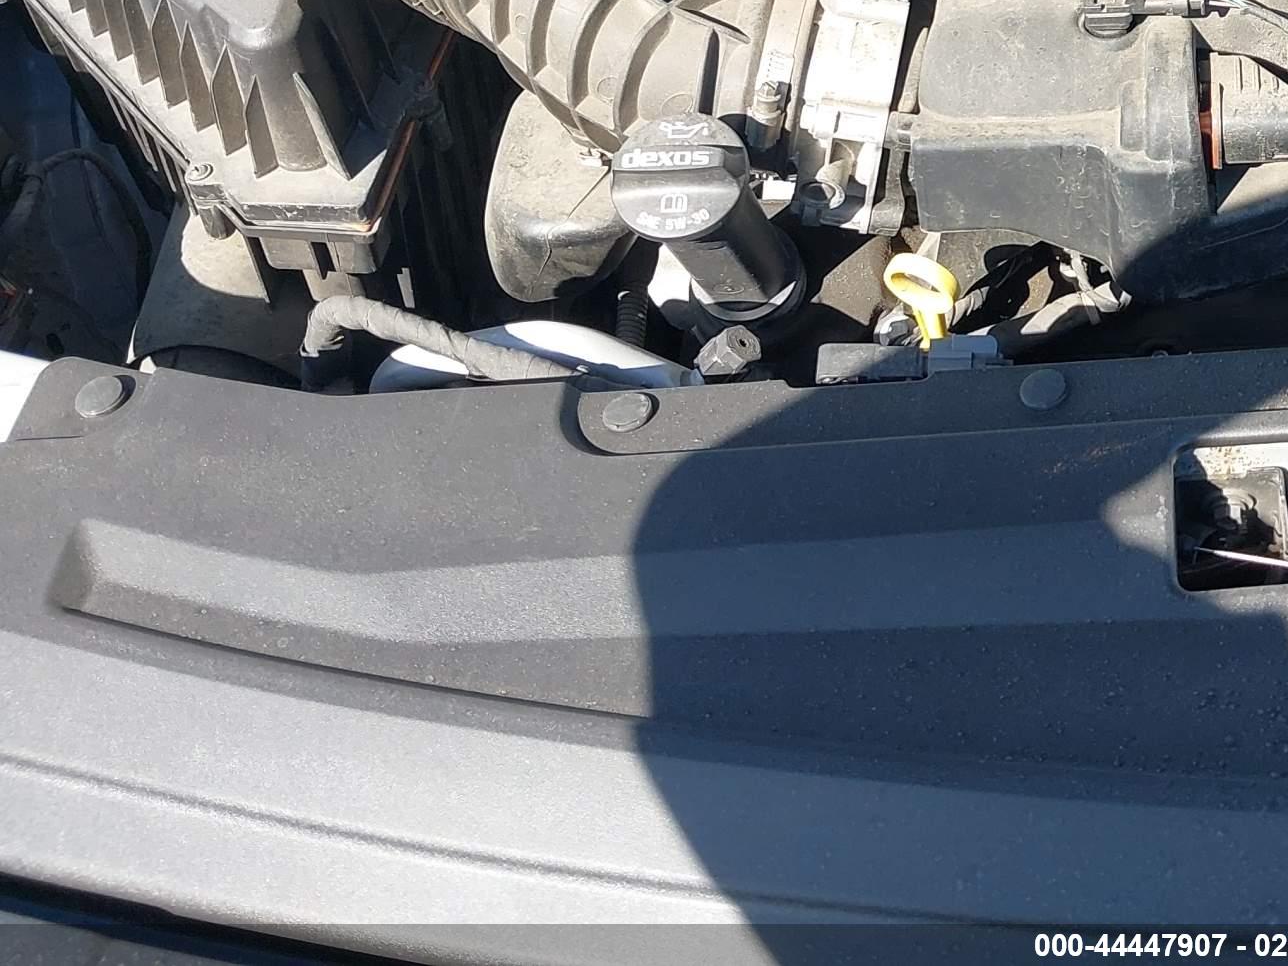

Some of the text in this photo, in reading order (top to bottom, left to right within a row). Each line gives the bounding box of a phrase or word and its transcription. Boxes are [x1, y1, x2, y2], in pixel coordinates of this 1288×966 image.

[621, 148, 711, 169] dexos
[636, 210, 710, 231] SAE 5W-30
